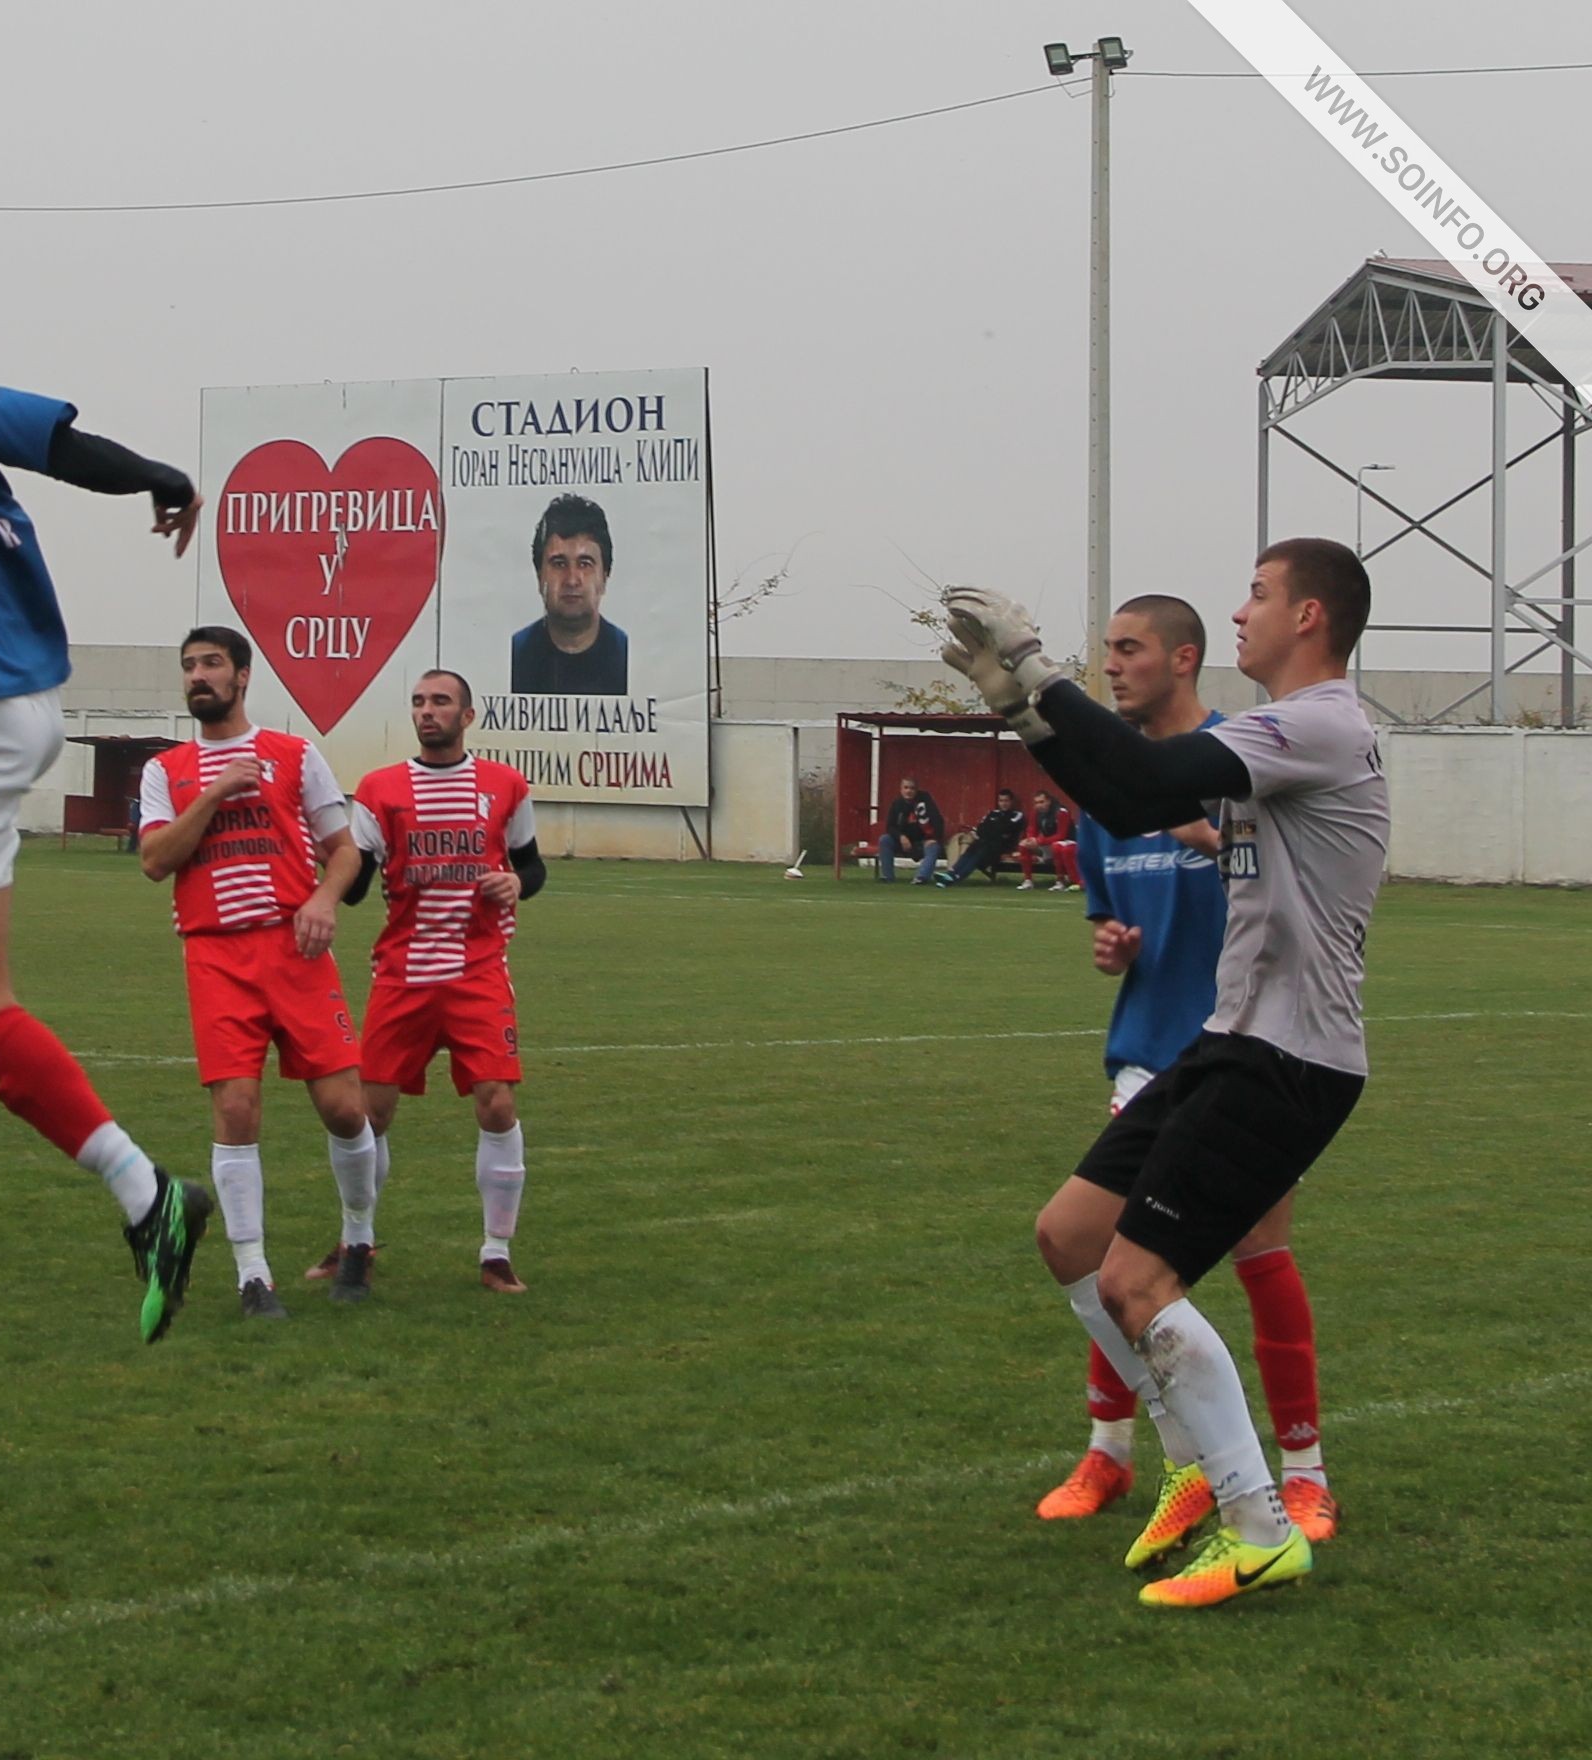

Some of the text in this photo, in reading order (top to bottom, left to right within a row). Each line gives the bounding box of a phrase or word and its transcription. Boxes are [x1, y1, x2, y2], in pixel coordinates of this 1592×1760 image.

[471, 395, 666, 438] СТАДИОН
[636, 438, 700, 483] КЛИПИ
[225, 488, 440, 534] ПРИГРЕВИЦА
[318, 553, 339, 596] У
[285, 615, 372, 660] СРЦУ
[480, 695, 658, 733] ЖИВИШ И ДАЉЕ
[577, 750, 674, 790] СРЦИМА
